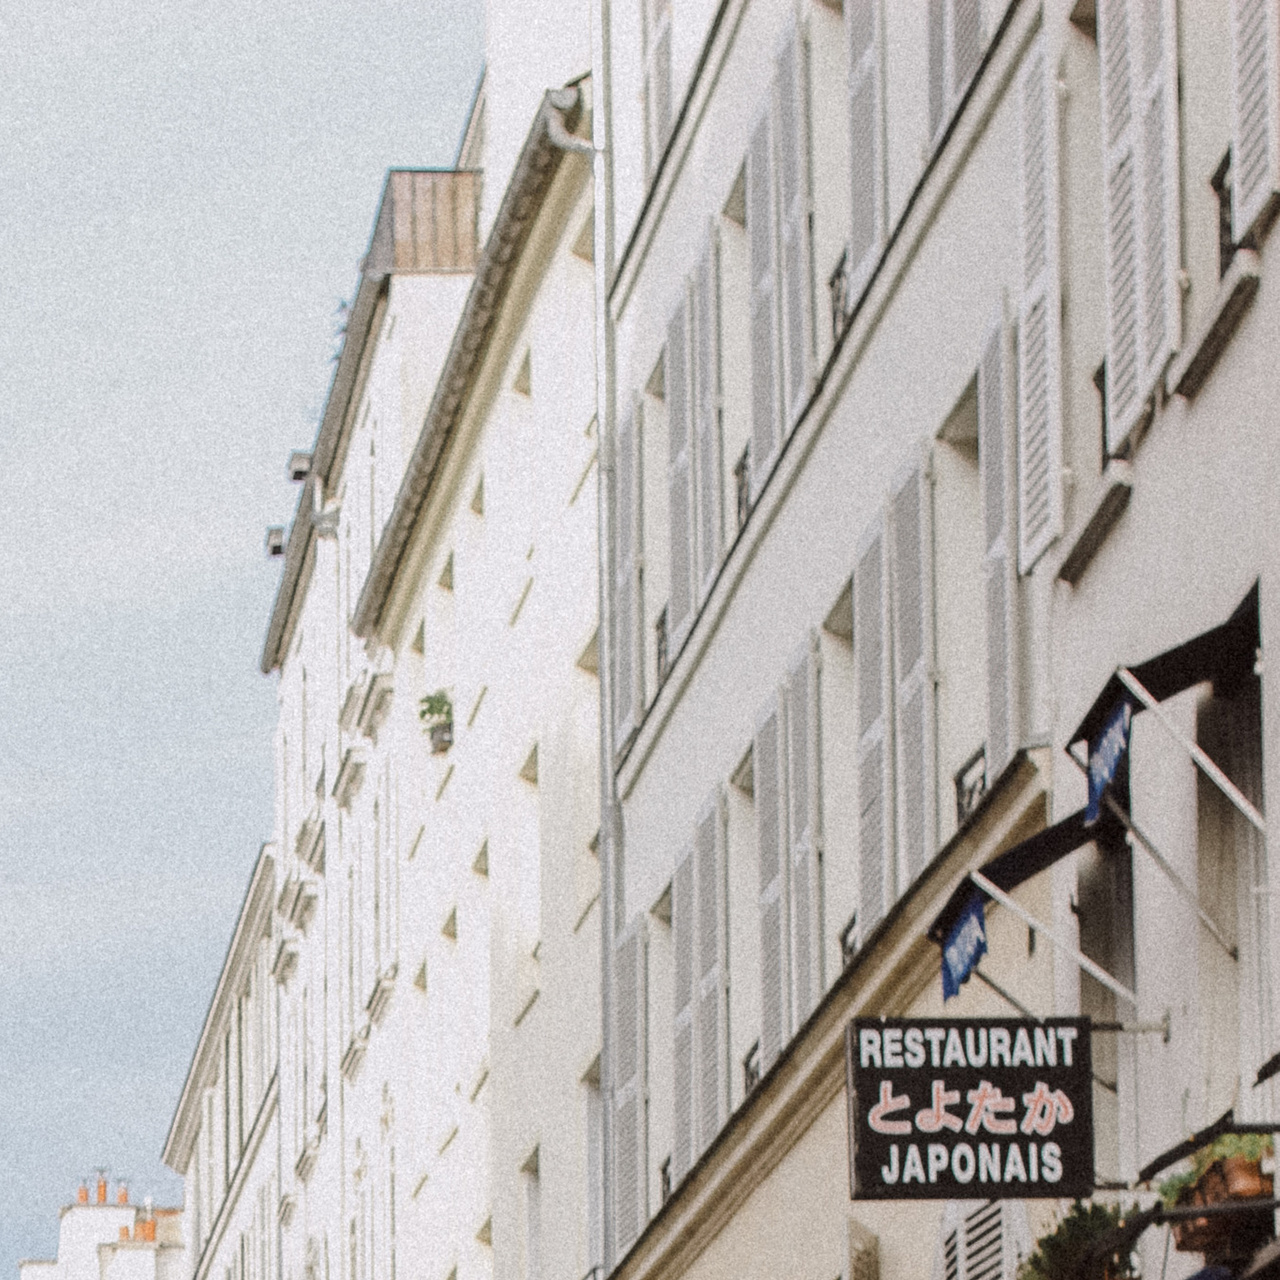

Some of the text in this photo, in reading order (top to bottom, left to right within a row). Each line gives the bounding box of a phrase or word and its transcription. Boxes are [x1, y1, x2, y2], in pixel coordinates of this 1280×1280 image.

[859, 1027, 1078, 1068] RESTAURANT
[867, 1079, 1075, 1136] とよたか
[881, 1142, 1063, 1184] JAPONAIS
